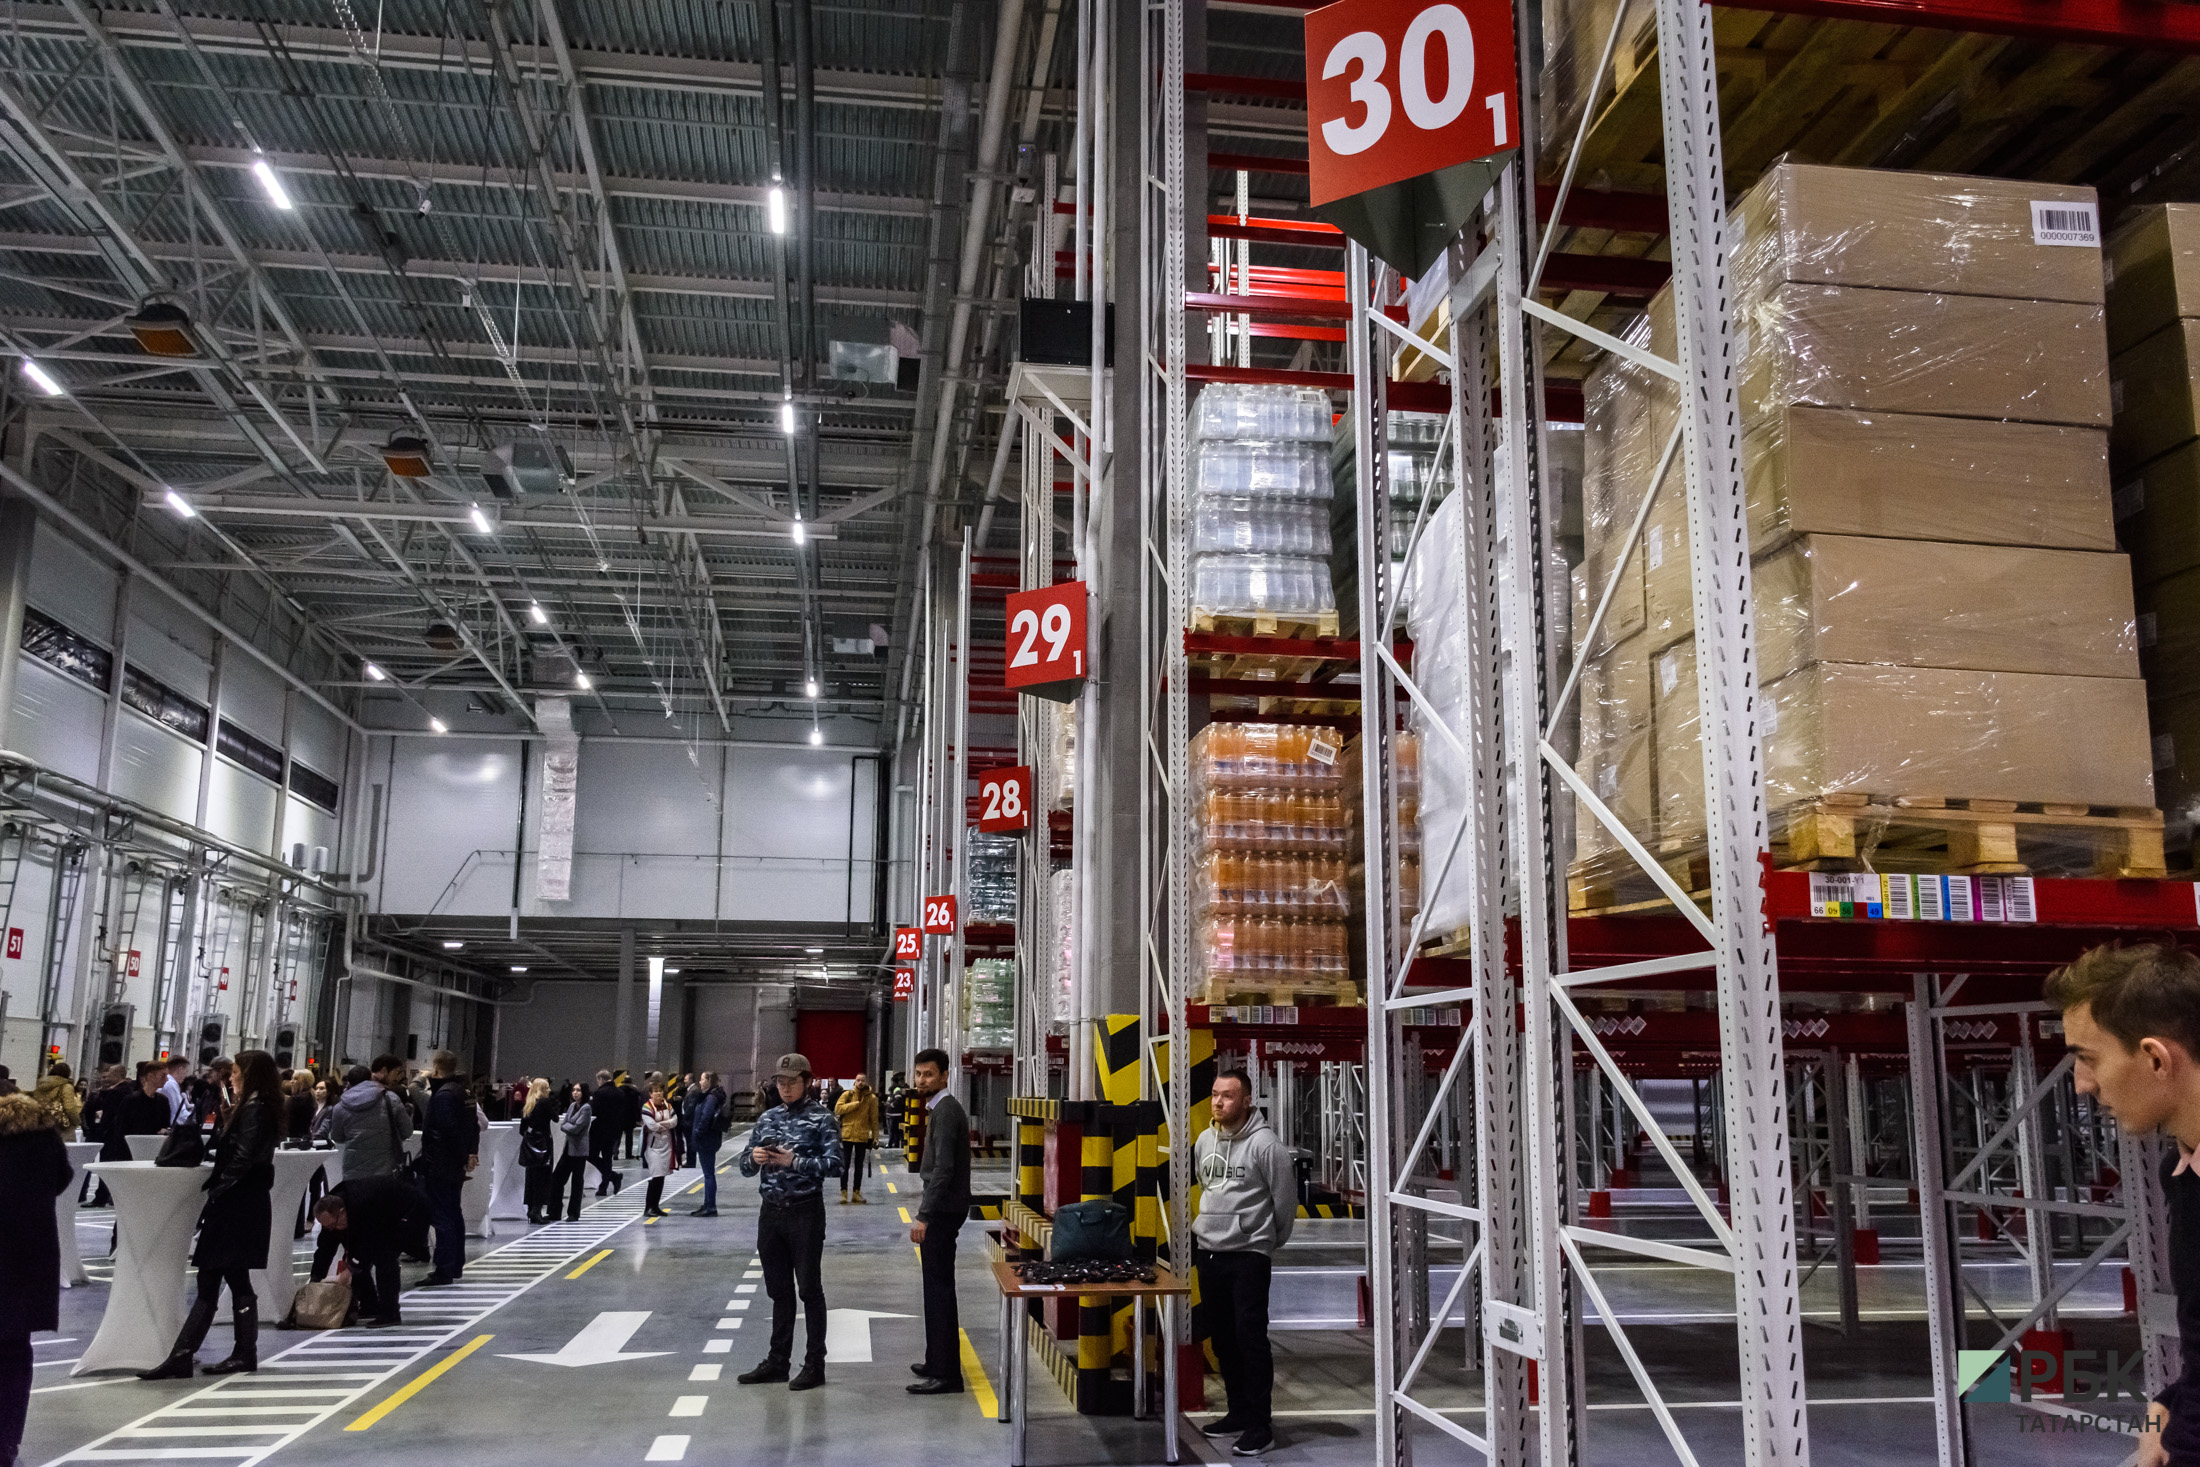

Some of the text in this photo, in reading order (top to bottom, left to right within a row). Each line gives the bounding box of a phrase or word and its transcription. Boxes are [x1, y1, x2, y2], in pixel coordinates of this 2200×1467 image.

[1321, 3, 1508, 156] 30 1
[2040, 231, 2095, 242] 0000007369
[1009, 603, 1082, 675] 29 1
[981, 779, 1028, 827] 28 1
[926, 902, 950, 927] 26
[1814, 906, 1824, 914] 66
[9, 935, 21, 953] 51
[897, 933, 917, 954] 25
[129, 956, 140, 971] 50
[896, 972, 911, 988] 23
